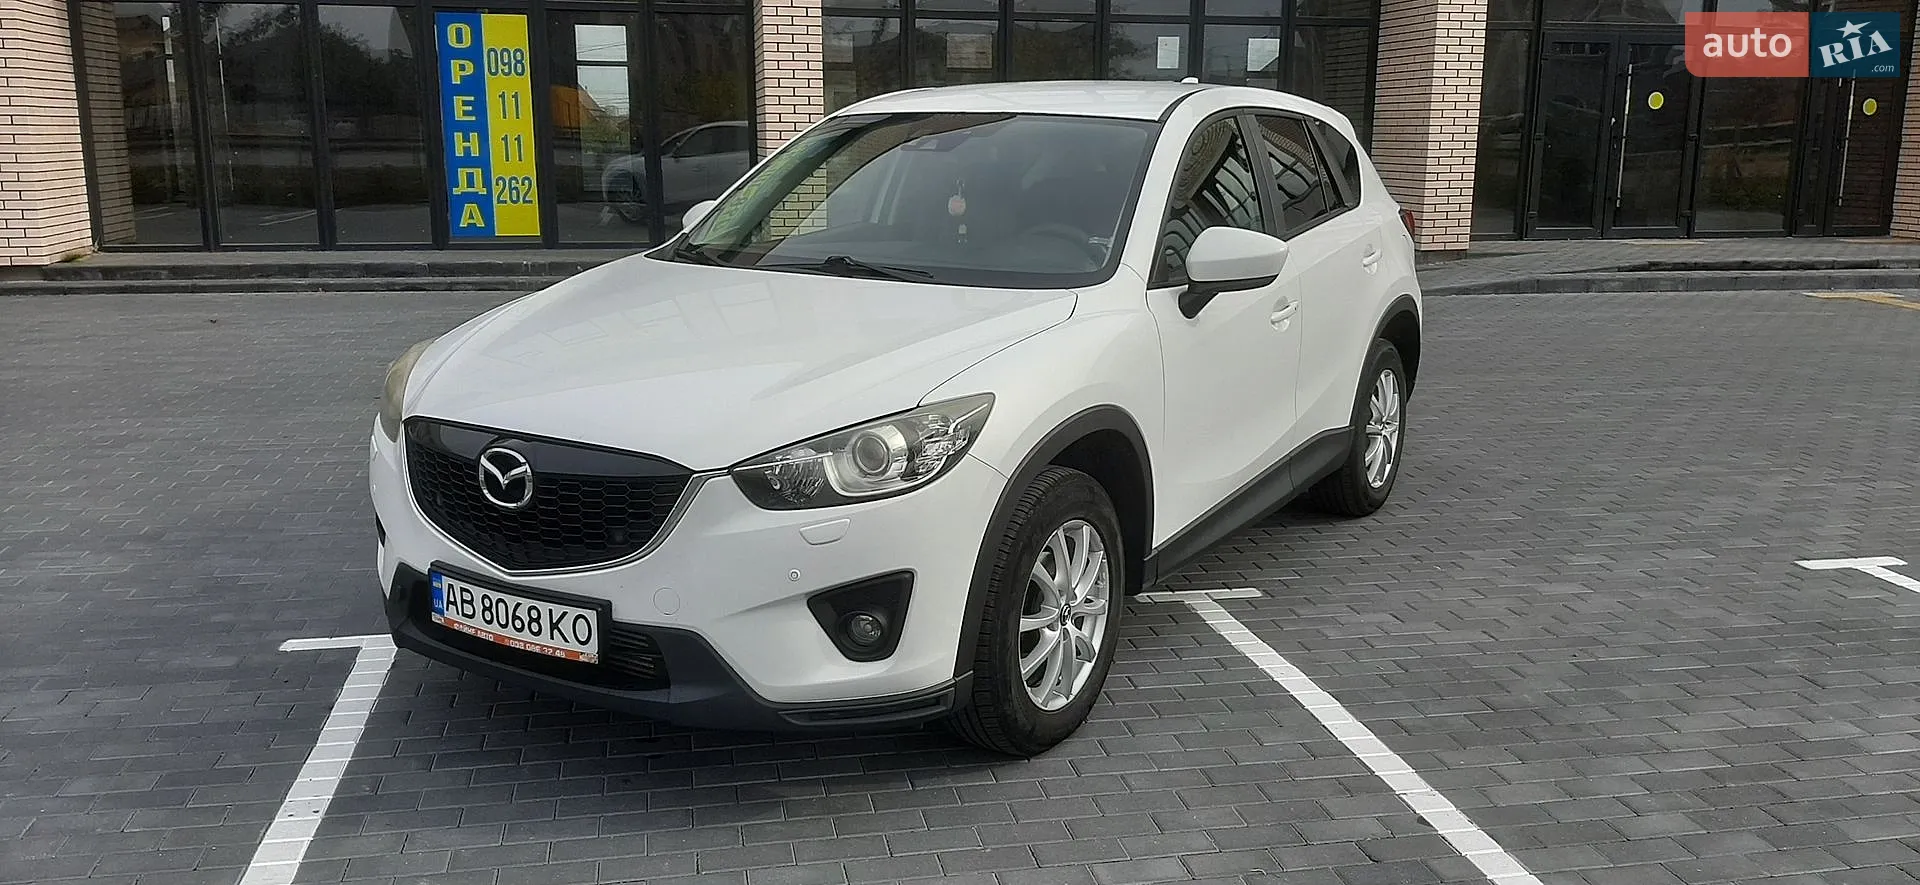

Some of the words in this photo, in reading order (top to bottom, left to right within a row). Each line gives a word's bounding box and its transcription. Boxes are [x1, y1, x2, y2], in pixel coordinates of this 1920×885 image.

[486, 48, 526, 77] 098
[498, 91, 521, 120] 11
[447, 23, 487, 228] ОРЕНДА
[501, 134, 525, 162] 11
[495, 176, 533, 205] 262
[433, 598, 444, 609] UA
[446, 583, 476, 620] AB
[480, 593, 543, 637] 8068
[548, 608, 593, 646] KO
